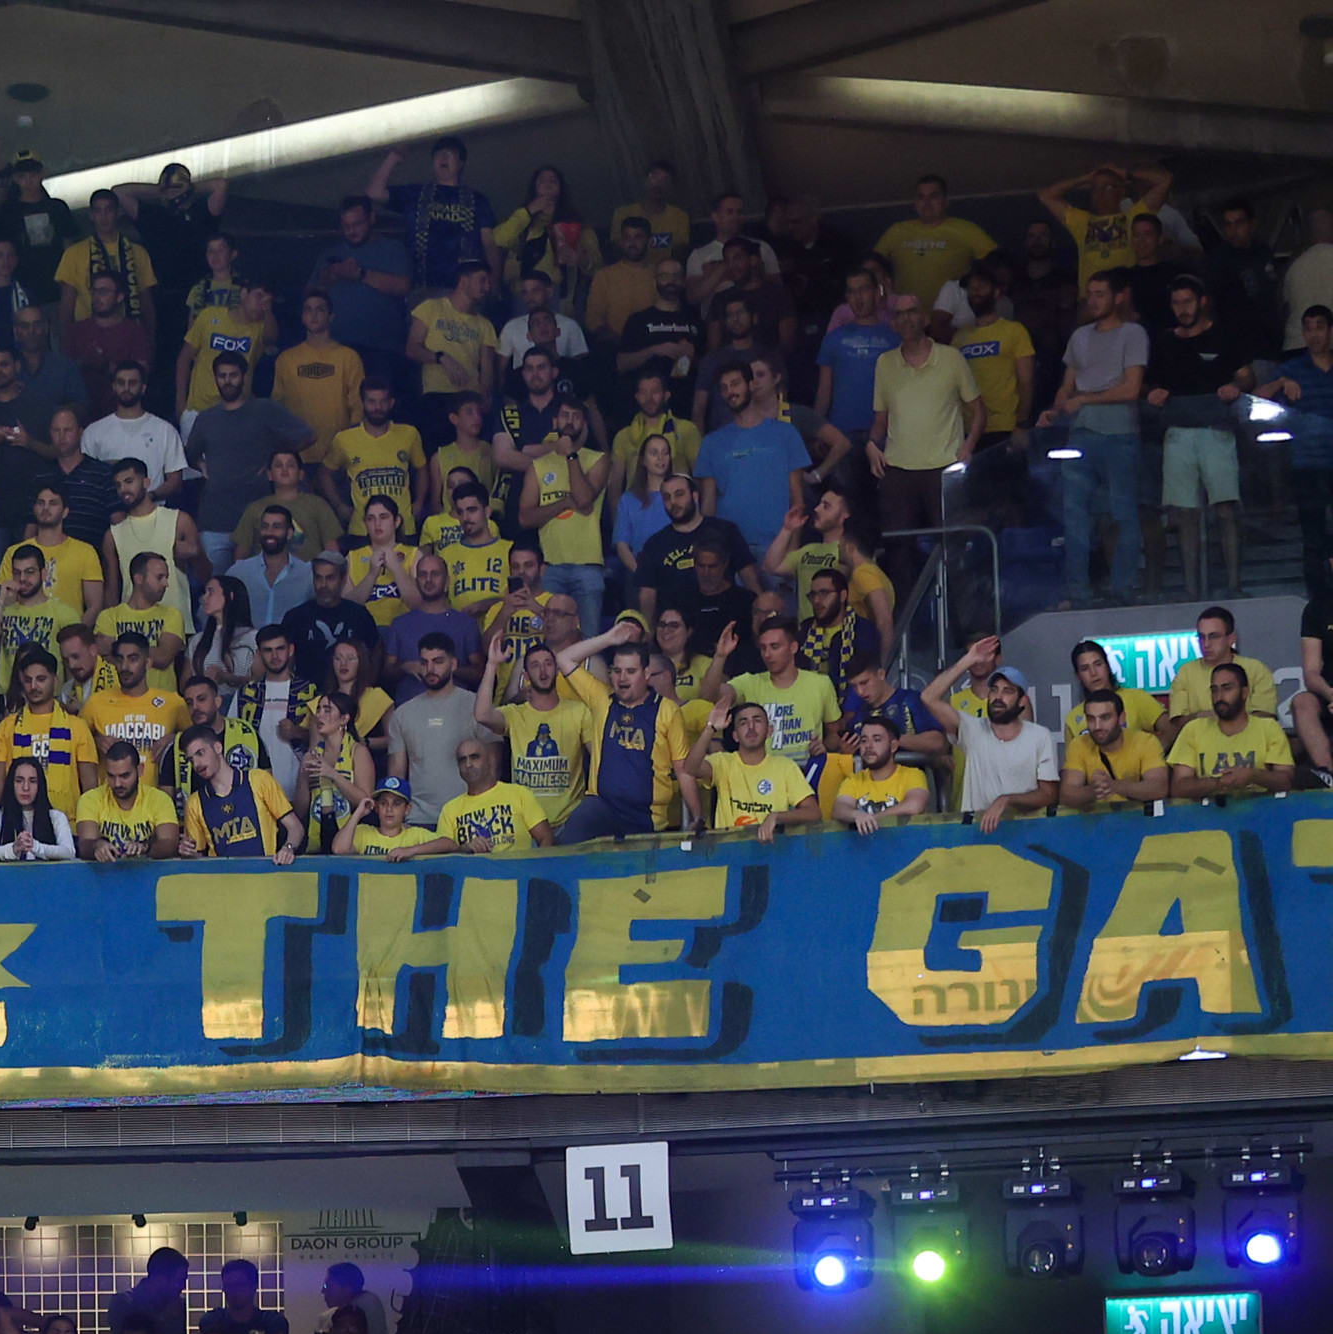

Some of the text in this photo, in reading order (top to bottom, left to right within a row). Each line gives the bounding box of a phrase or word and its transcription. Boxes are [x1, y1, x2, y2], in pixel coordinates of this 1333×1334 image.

[212, 336, 248, 352] FOX
[485, 558, 503, 573] 12
[454, 577, 500, 594] ELITE
[515, 757, 568, 771] MAXIMUM
[513, 771, 570, 789] MADNESS
[155, 818, 1333, 1043] THE GA
[583, 1164, 655, 1232] 11
[290, 1235, 404, 1251] DAON GROUP
